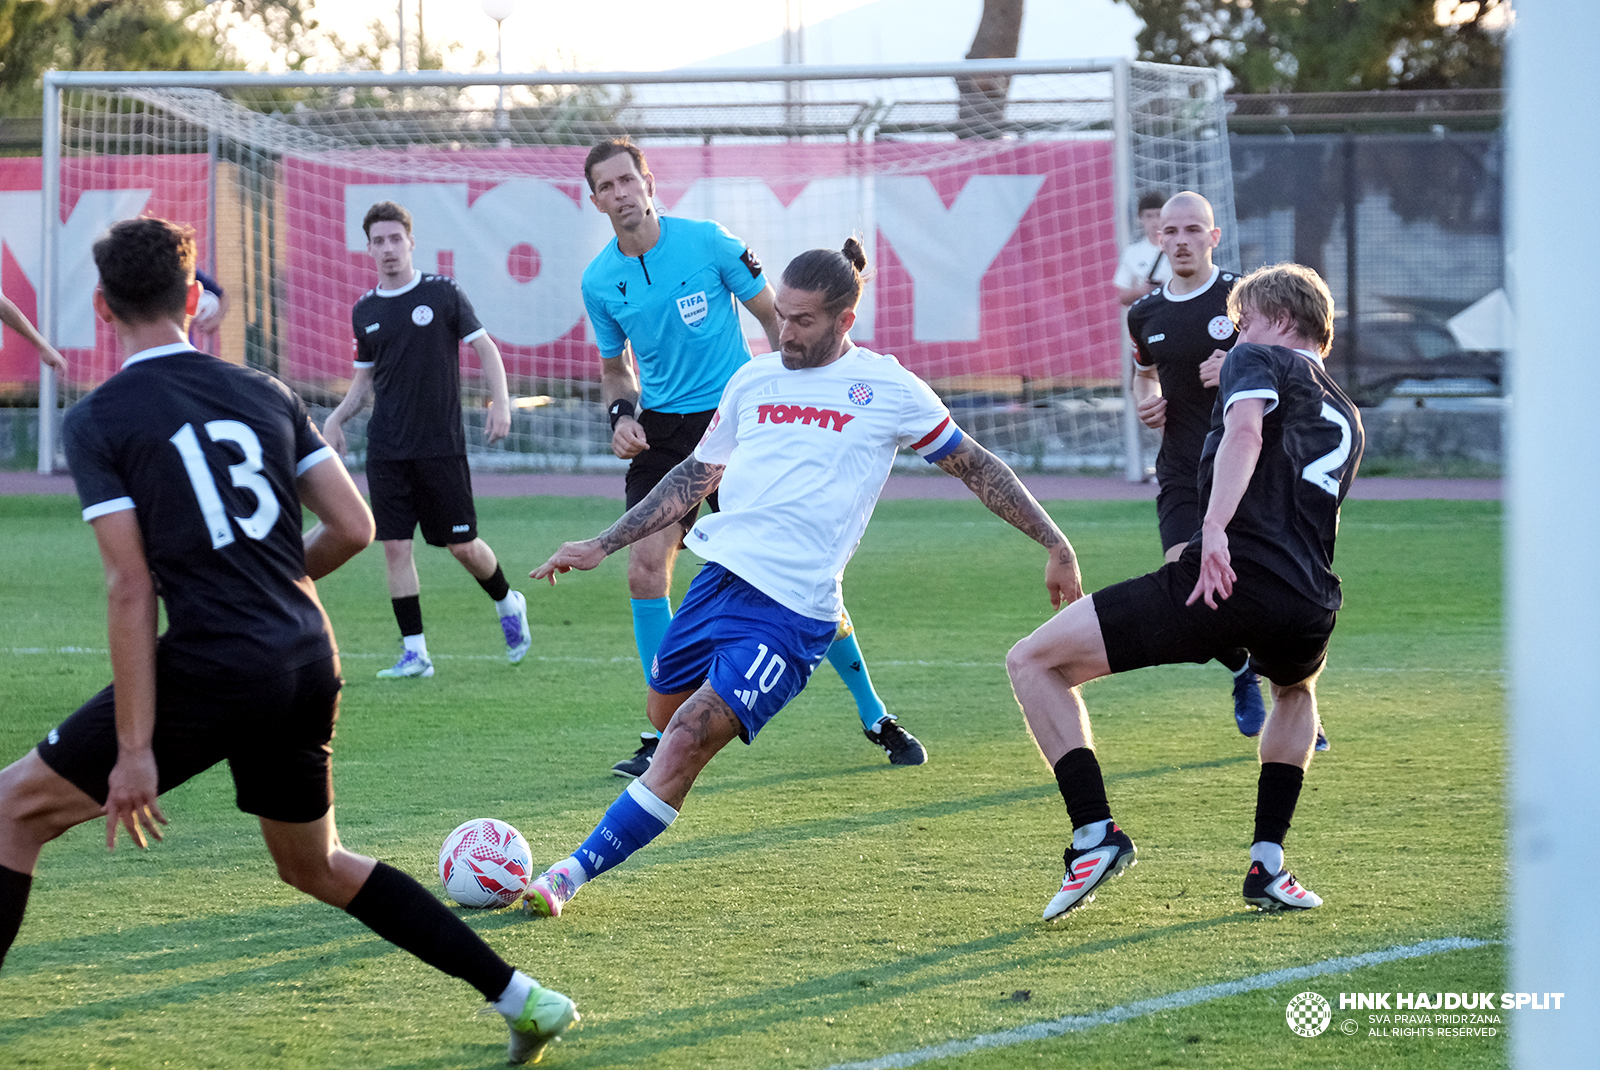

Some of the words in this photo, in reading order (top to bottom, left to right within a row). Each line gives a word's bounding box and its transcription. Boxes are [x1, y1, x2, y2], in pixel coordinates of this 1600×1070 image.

[680, 295, 704, 309] FIFA
[684, 307, 706, 318] REFEREE
[757, 404, 855, 433] TOMMY
[1302, 401, 1352, 498] 2
[169, 419, 281, 550] 13
[744, 643, 787, 694] 10
[600, 826, 622, 850] 1911
